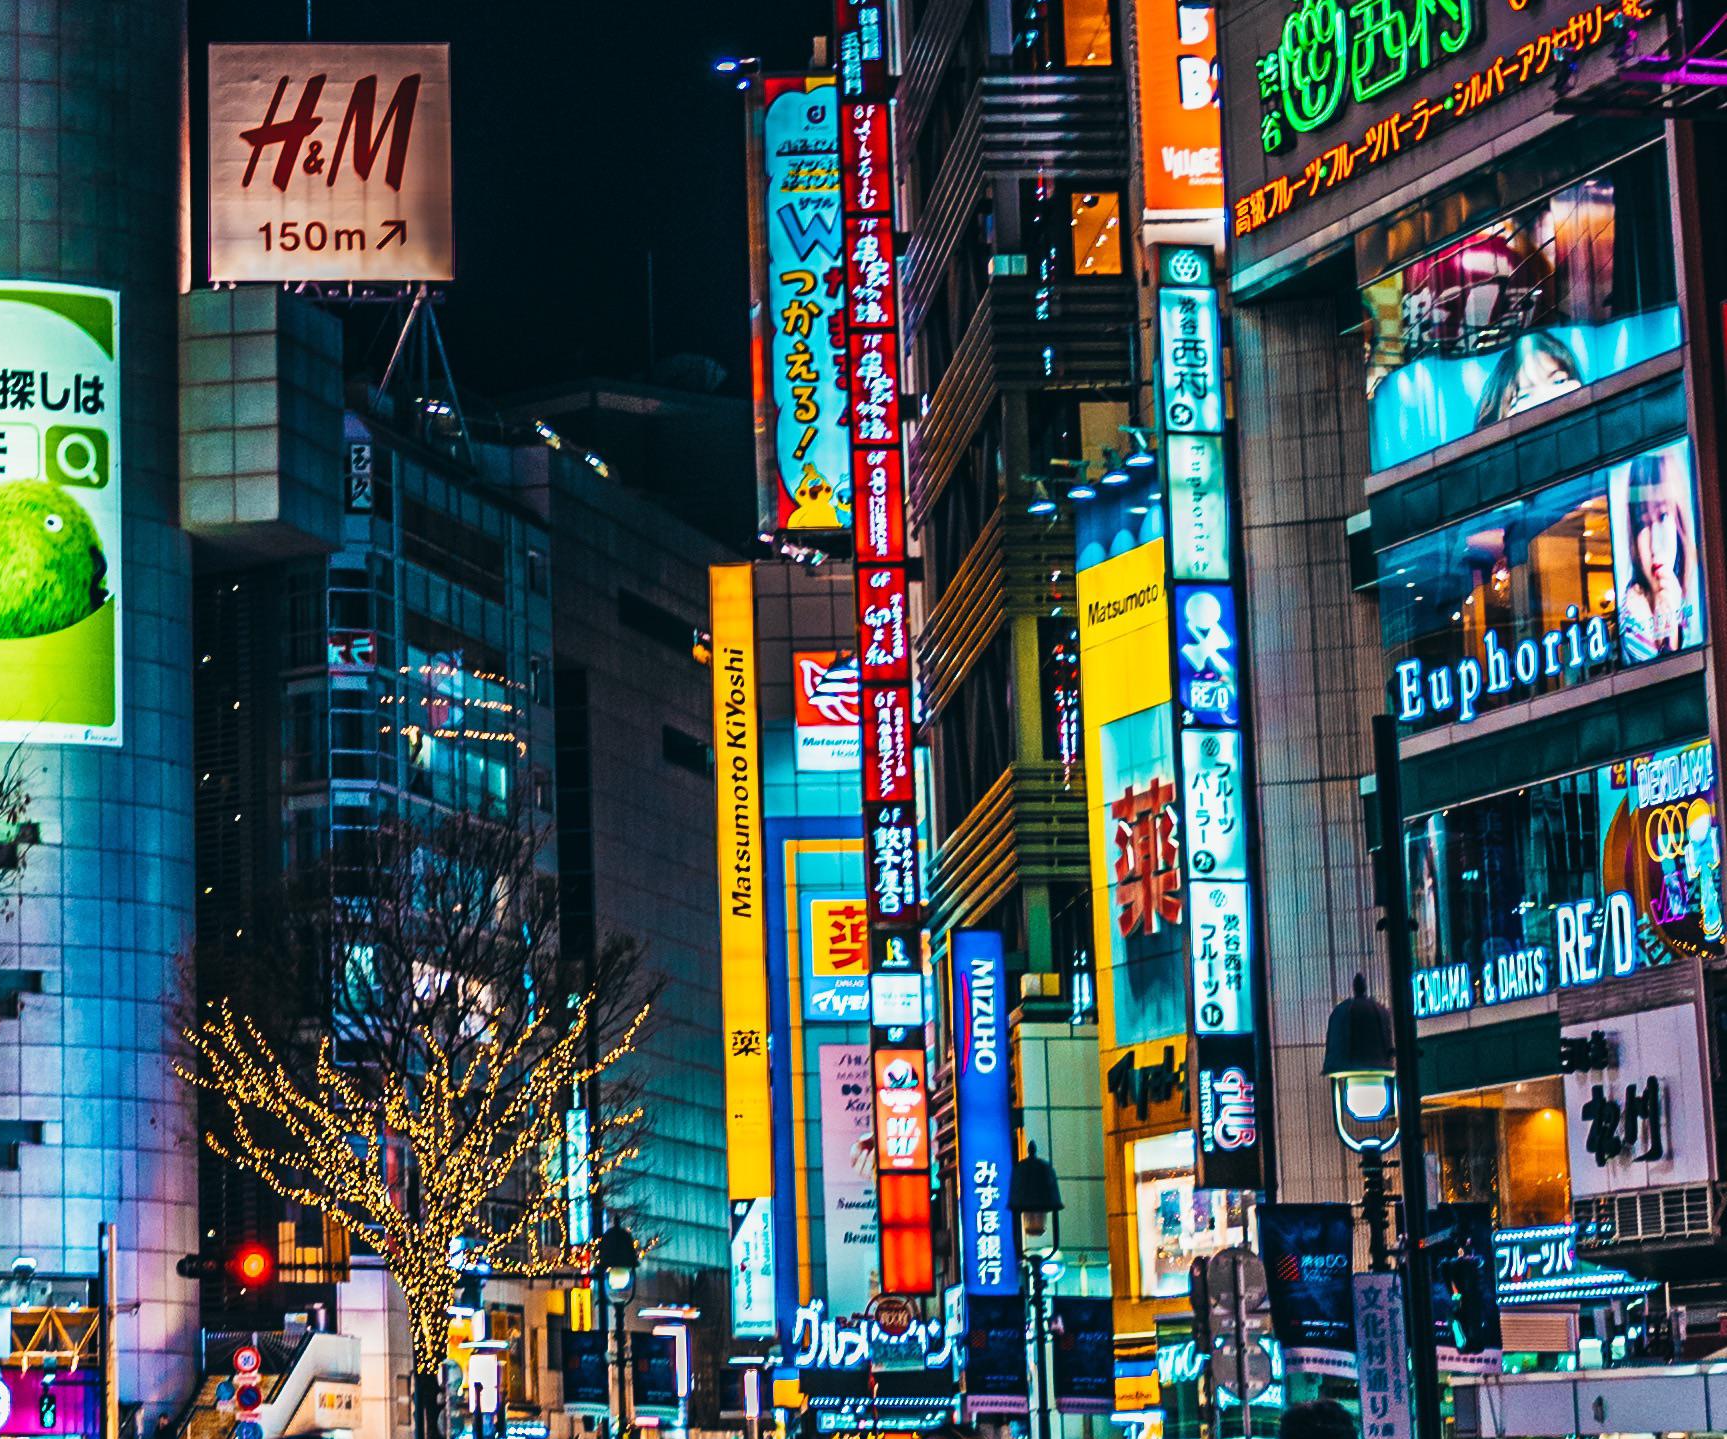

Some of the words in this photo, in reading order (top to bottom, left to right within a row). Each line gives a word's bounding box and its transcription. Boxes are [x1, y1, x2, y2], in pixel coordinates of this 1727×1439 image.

[239, 73, 422, 193] H&M
[854, 106, 875, 119] 8F
[1255, 50, 1282, 154] 渋谷
[258, 220, 366, 252] 150m
[780, 269, 821, 459] つかえる!
[1172, 294, 1208, 401] 渋谷西村
[1087, 583, 1159, 628] Matsumoto
[874, 691, 896, 708] 6F
[1395, 605, 1609, 723] Euphoria
[731, 755, 753, 919] Matsumoto
[879, 807, 901, 823] 6F
[1191, 771, 1211, 845] パーラー
[1213, 762, 1235, 836] フルーツ
[874, 825, 904, 913] 餃子屋台
[1112, 777, 1183, 938] 薬
[1200, 923, 1220, 998] フルーツ
[1223, 913, 1243, 992] 渋谷西村
[1497, 946, 1548, 1002] DARTS
[1556, 890, 1636, 989] RE/D
[731, 1029, 762, 1057] 薬
[971, 959, 997, 1075] MIZUHO
[973, 1160, 1002, 1285] みずほ銀行
[1498, 1240, 1573, 1278] フルーツパ
[1361, 1285, 1390, 1420] 文化村通り
